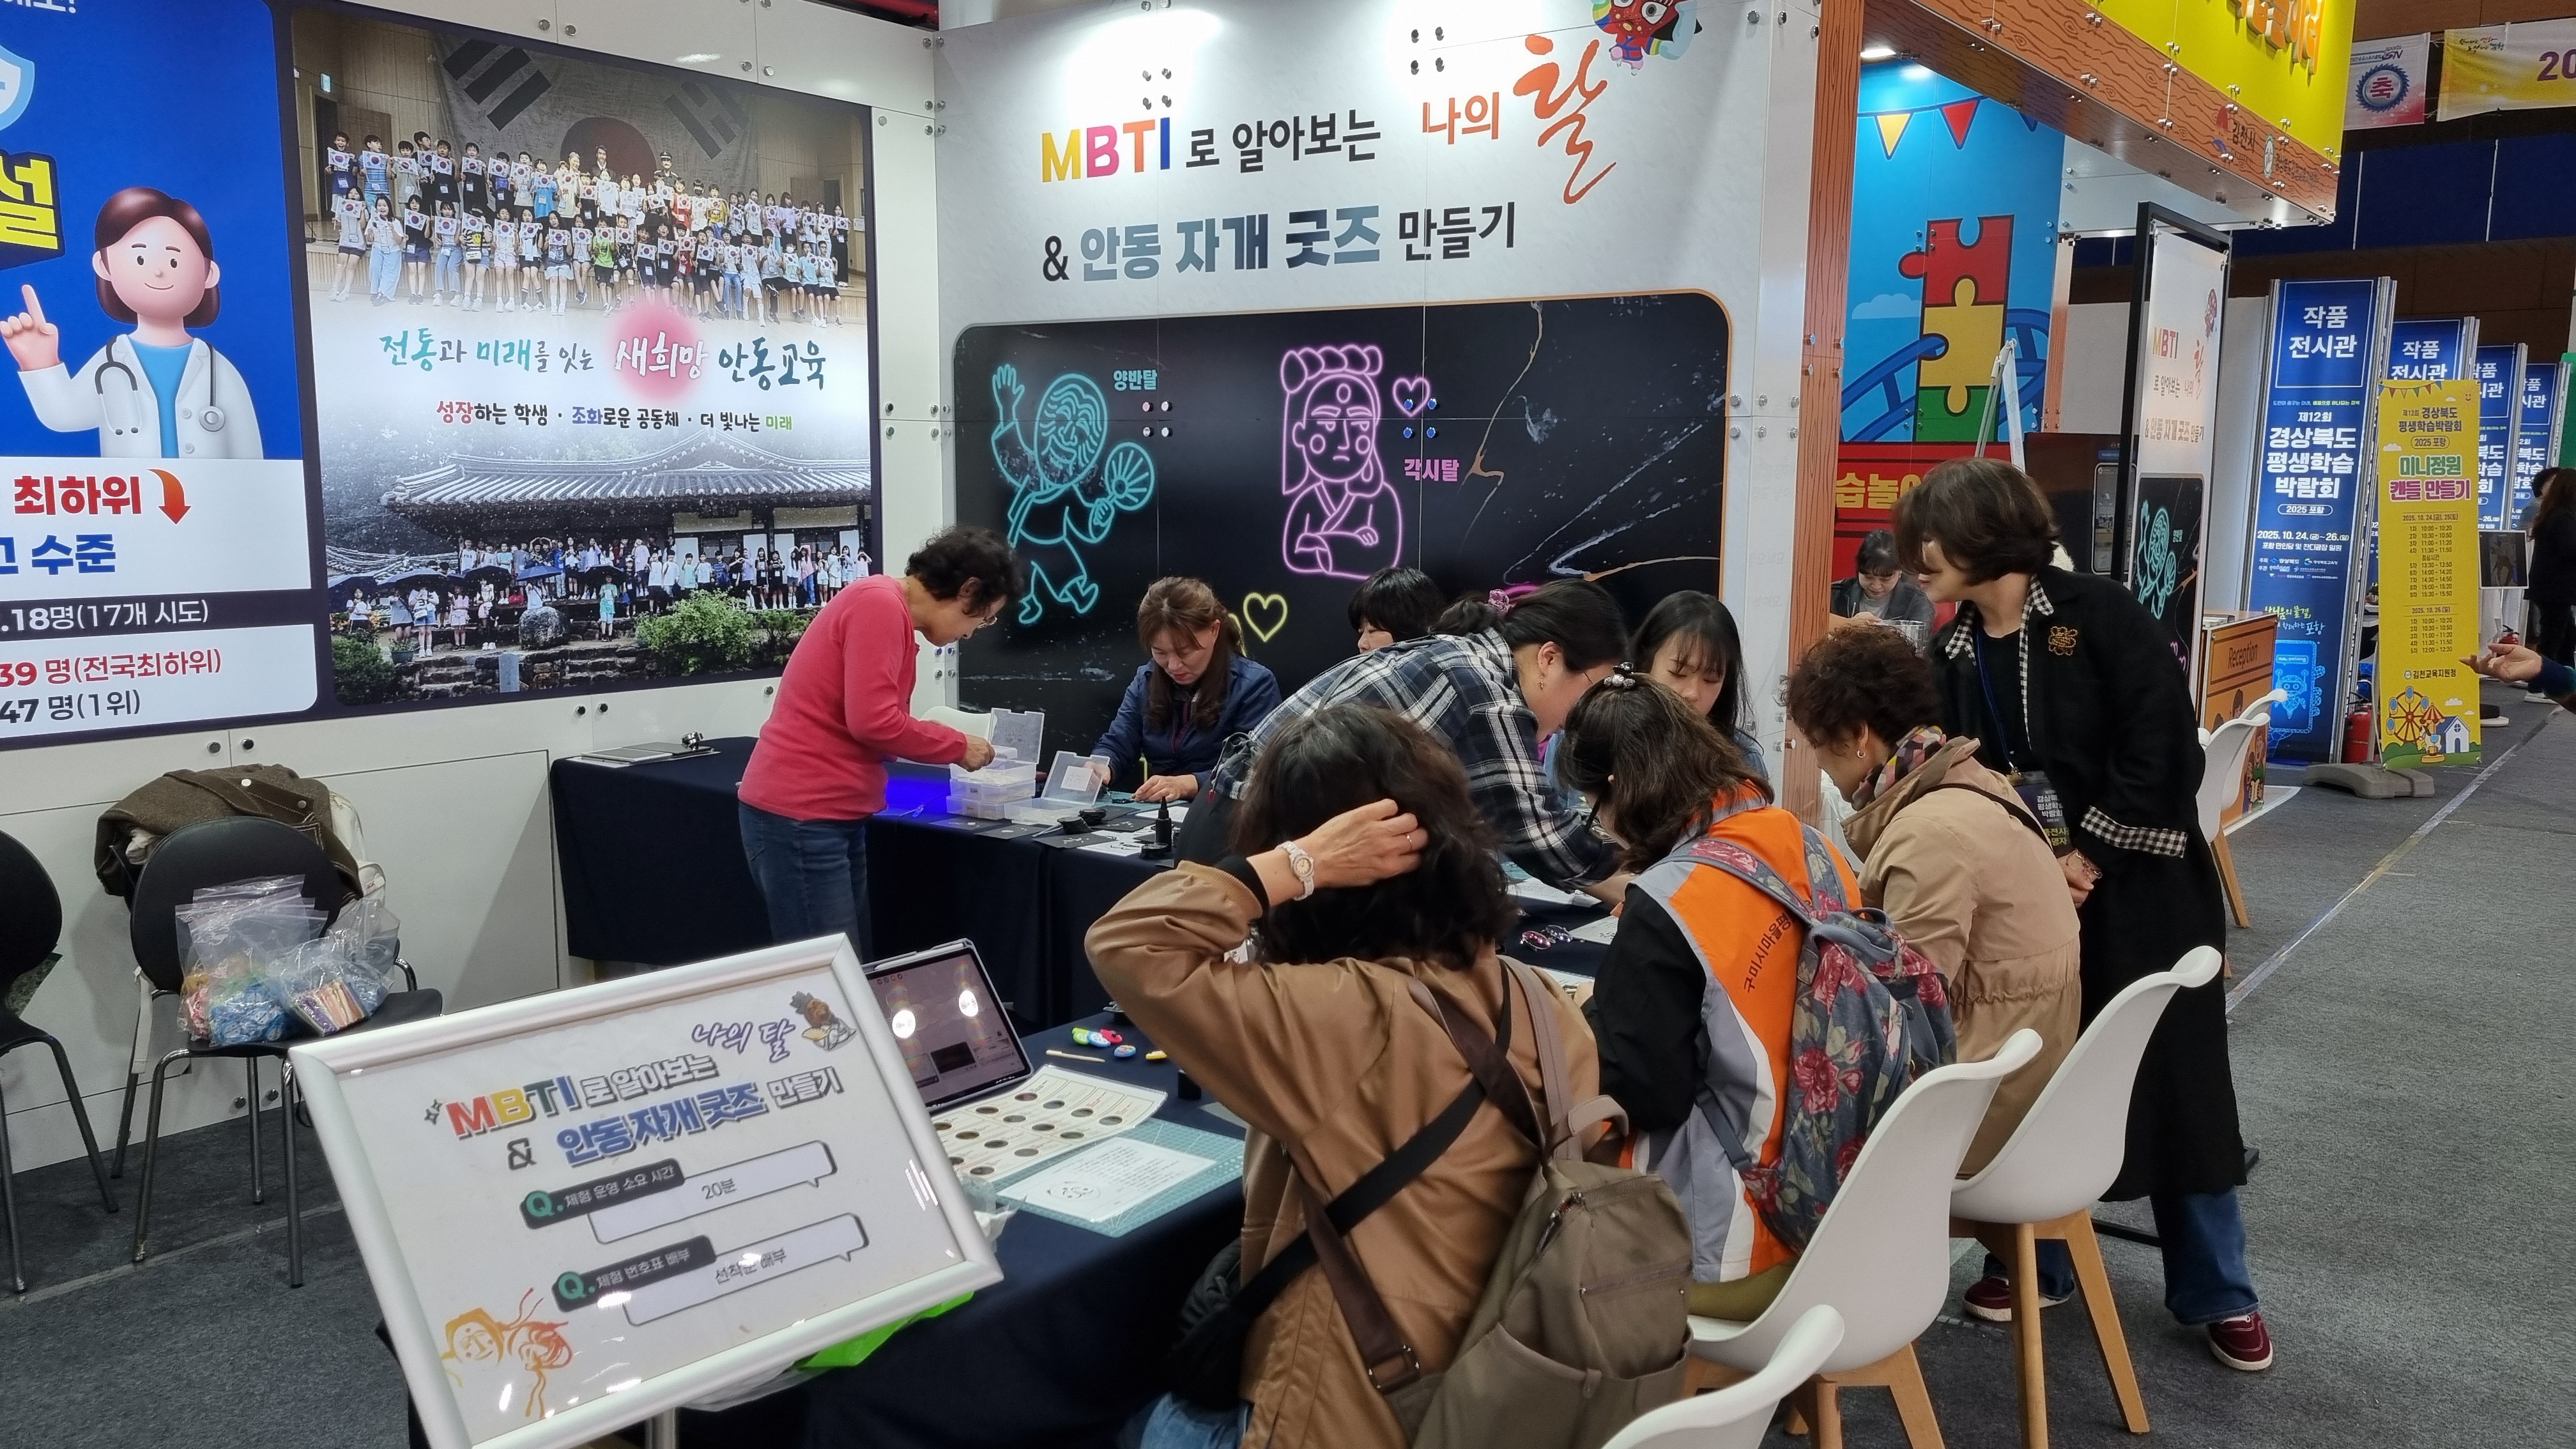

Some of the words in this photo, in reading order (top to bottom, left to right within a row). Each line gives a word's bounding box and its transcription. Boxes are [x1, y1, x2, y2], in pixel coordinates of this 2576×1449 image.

[2370, 77, 2394, 100] 축
[1041, 117, 1170, 182] MBTI
[1186, 128, 1220, 168] 로
[1232, 109, 1381, 173] 알아보는
[1422, 92, 1499, 145] 나의
[1513, 34, 1616, 204] 탈
[1043, 235, 1070, 282] &
[1080, 224, 1161, 282] 안동
[1175, 213, 1268, 273] 자개
[1285, 205, 1381, 269] 굿즈
[1399, 201, 1515, 261] 만들기
[2303, 305, 2348, 328] 작품
[379, 327, 467, 372] 전통과
[477, 339, 550, 372] 미래를
[559, 342, 595, 374] 잇는
[615, 331, 709, 379] 새희망
[2152, 326, 2179, 359] MBTI
[2289, 335, 2357, 358] 전시관
[2402, 341, 2440, 360] 작품
[1114, 370, 1158, 391] 양반탈
[2391, 364, 2448, 381] 전시관
[2160, 376, 2181, 399] 알아보는
[2184, 379, 2194, 397] 나의
[436, 401, 507, 425] 성장하는
[514, 403, 548, 426] 학생
[572, 406, 631, 429] 조화로운
[637, 408, 679, 429] 공동체
[700, 413, 714, 428] 더
[720, 412, 760, 432] 빛나는
[766, 416, 792, 431] 미래
[2298, 412, 2332, 422] 제12회
[2421, 407, 2458, 418] 경상북도
[2145, 418, 2150, 438] &
[2150, 417, 2163, 441] 안동
[2164, 418, 2177, 441] 자개
[2177, 420, 2190, 441] 굿즈
[2191, 425, 2204, 443] 만들기
[2269, 427, 2356, 448] 경상북도
[2398, 420, 2462, 433] 평생학습박람회
[2414, 438, 2431, 447] 2025
[2433, 438, 2446, 447] 포항
[1404, 459, 1459, 482] 각시탈
[2267, 452, 2354, 473] 평생학습
[2400, 456, 2462, 476] 미니정원
[14, 475, 141, 515] 최하위
[2275, 477, 2340, 498] 박람회
[2389, 480, 2421, 501] 캔들
[2425, 479, 2471, 500] 만들기
[2257, 530, 2280, 539] 2025.
[2283, 531, 2294, 540] 10.
[31, 534, 116, 575] 수준
[155, 599, 208, 624] 시도)
[2306, 620, 2326, 636] 포항
[45, 648, 221, 685] 명(전국최하위)
[2228, 641, 2258, 670] Reception
[2413, 669, 2457, 679] 김천교육지원청
[48, 689, 141, 721] 명(1위)
[691, 1022, 753, 1054] 나의
[760, 1018, 796, 1063] 탈
[446, 1076, 581, 1141] MBTI
[611, 1054, 720, 1101] 알아보는
[507, 1137, 538, 1170] &
[556, 1118, 637, 1169] 안동
[630, 1100, 705, 1147] 자개
[697, 1082, 770, 1129] 굿즈
[768, 1067, 845, 1108] 만들기
[564, 1189, 592, 1208] 체험
[594, 1181, 620, 1199] 운영
[623, 1173, 649, 1192] 소요
[651, 1165, 677, 1183] 시간
[702, 1177, 738, 1200] 20분
[595, 1269, 624, 1289] 체험
[624, 1255, 665, 1280] 번호표
[665, 1246, 691, 1267] 배부
